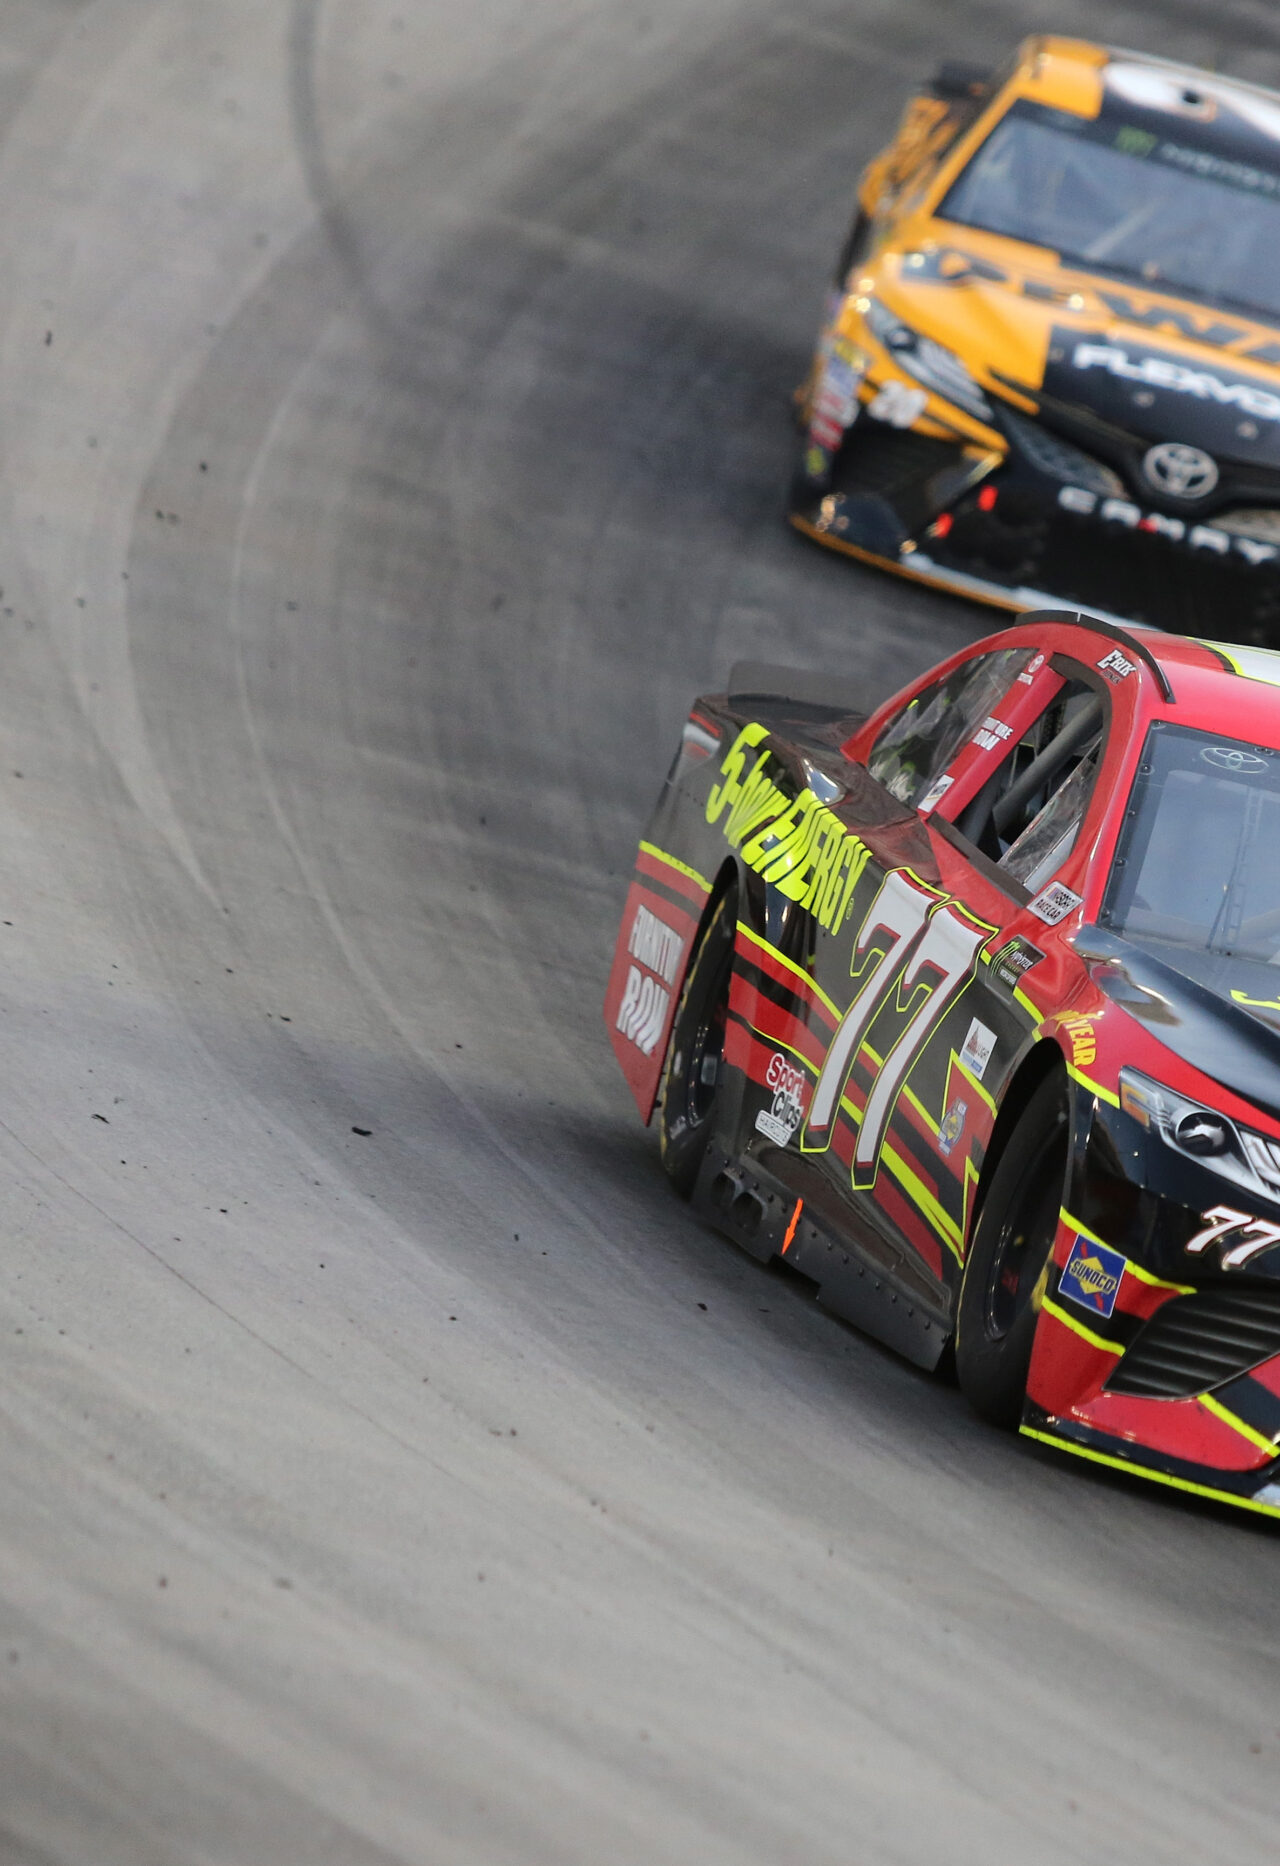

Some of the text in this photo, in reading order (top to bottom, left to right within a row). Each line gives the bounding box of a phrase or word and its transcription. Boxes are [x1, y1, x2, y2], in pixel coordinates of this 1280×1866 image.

[1058, 486, 1280, 562] CAMRY
[1097, 649, 1137, 677] ERIK
[740, 788, 873, 936] ENERGY
[617, 964, 671, 1058] ROW
[801, 867, 999, 1190] 77
[772, 1090, 803, 1131] Clips
[1068, 1258, 1119, 1296] SUNOCO
